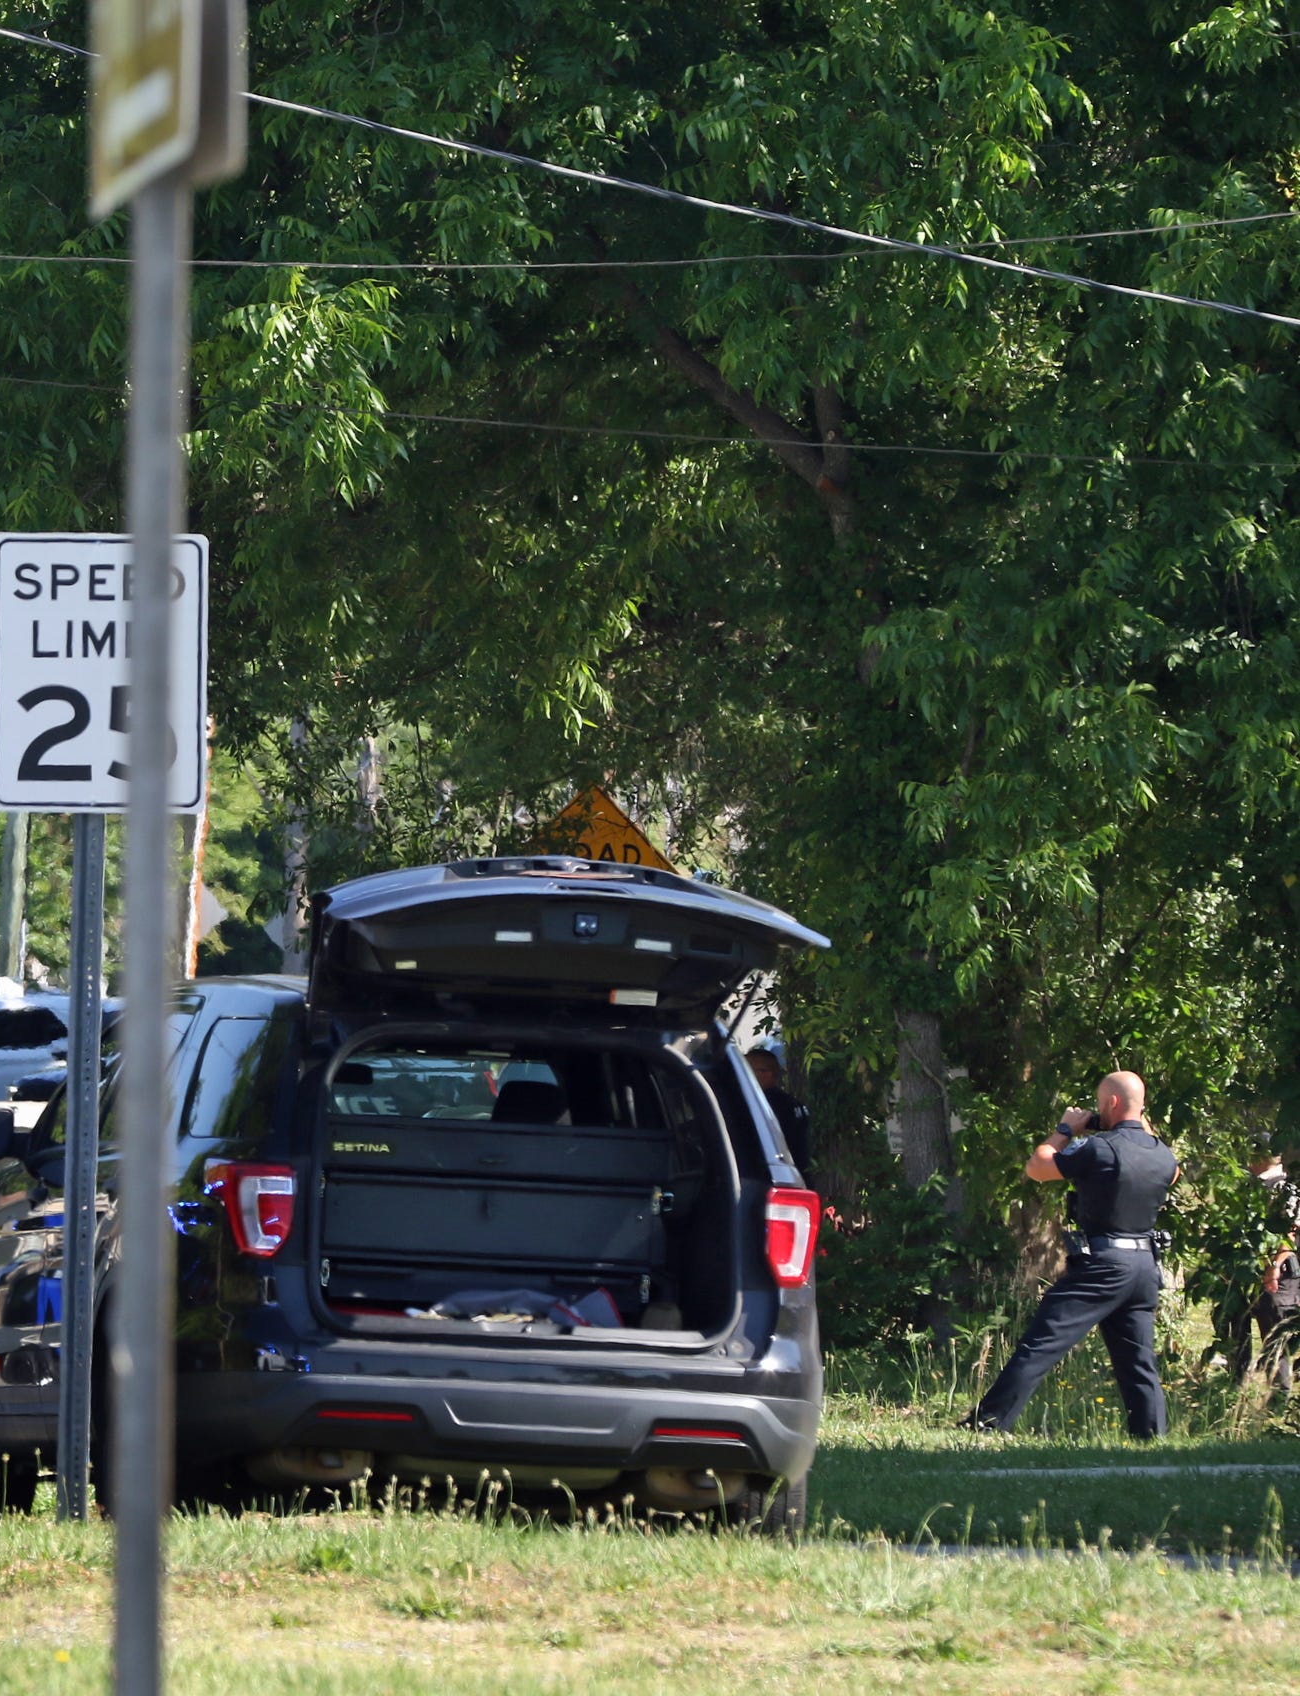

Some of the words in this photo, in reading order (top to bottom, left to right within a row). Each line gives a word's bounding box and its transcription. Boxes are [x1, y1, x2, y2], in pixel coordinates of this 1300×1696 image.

[32, 619, 134, 659] LIMI
[574, 842, 642, 865] OAD
[332, 1142, 390, 1153] SETINA
